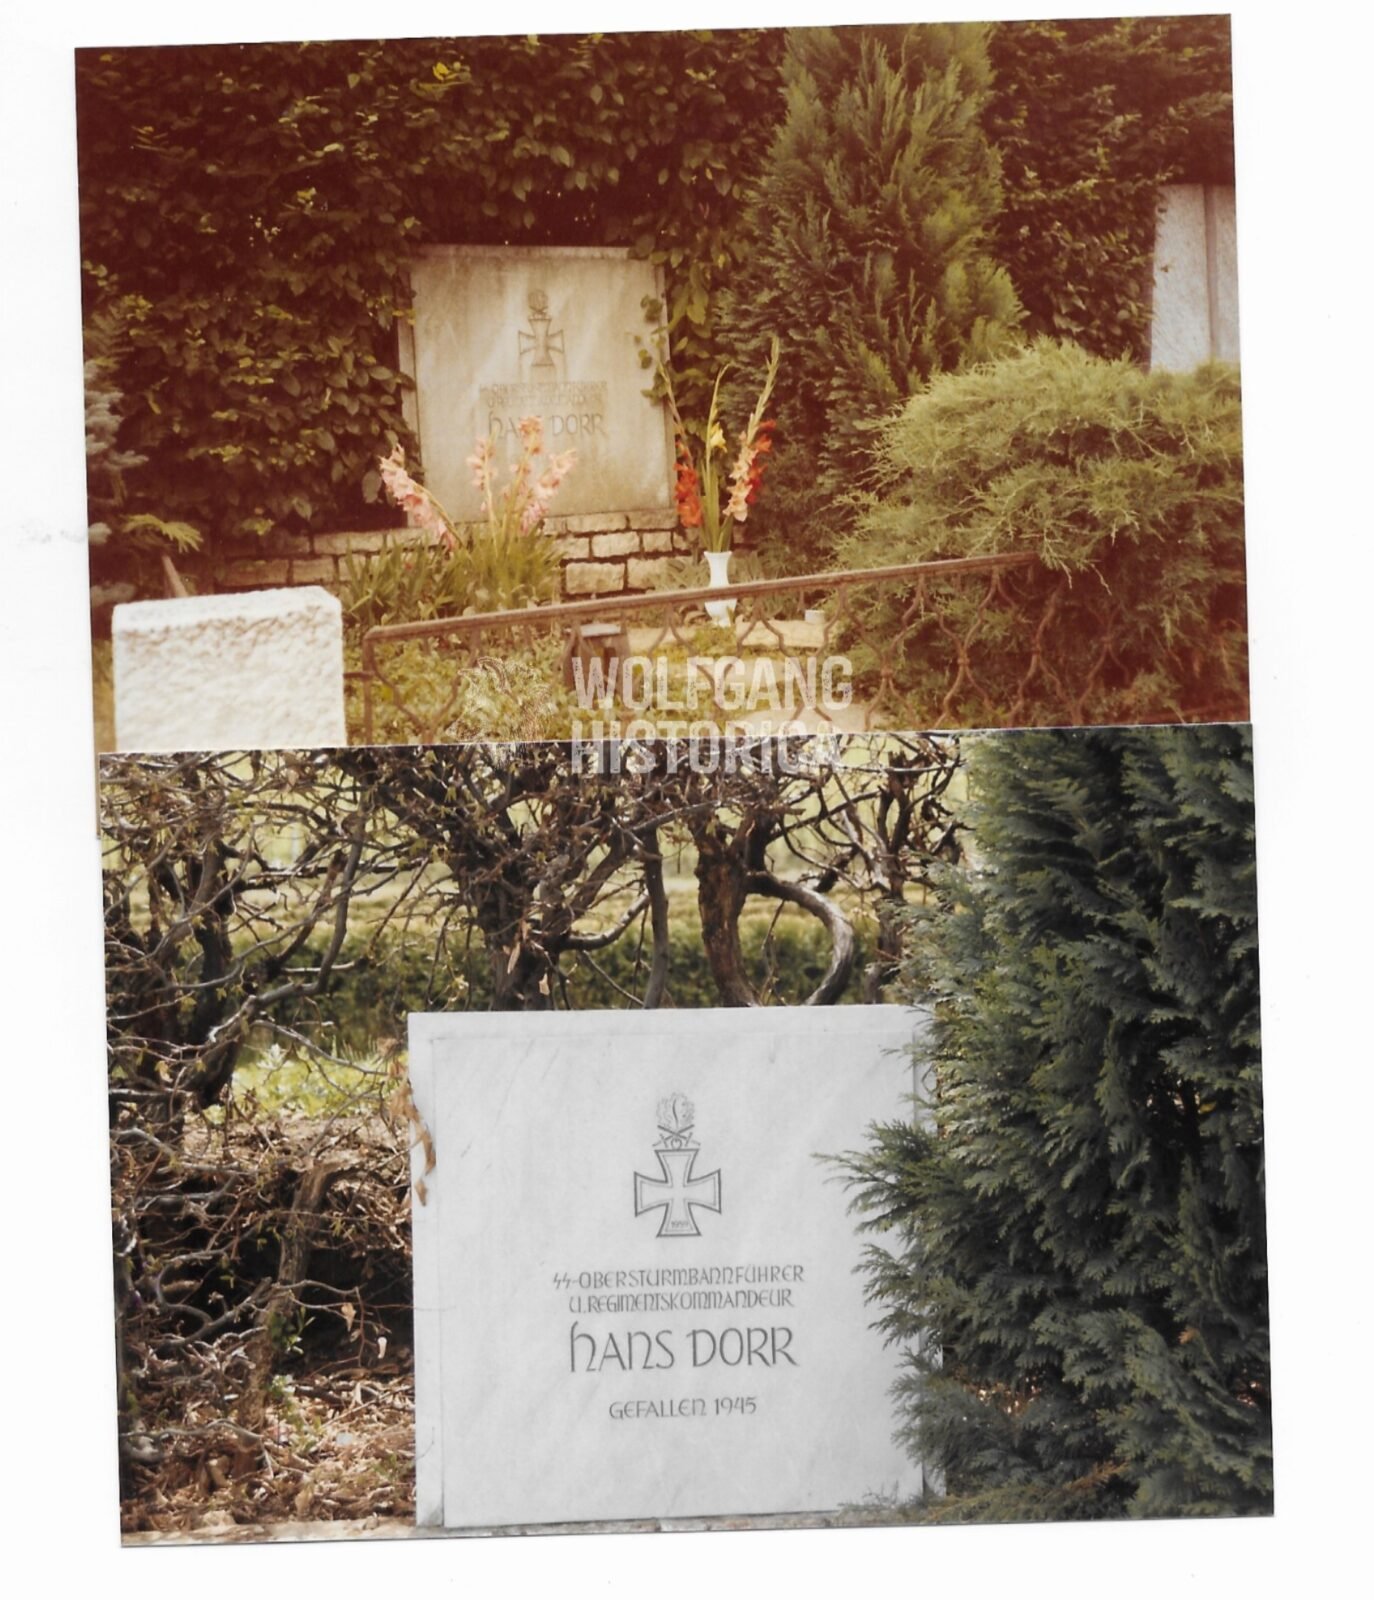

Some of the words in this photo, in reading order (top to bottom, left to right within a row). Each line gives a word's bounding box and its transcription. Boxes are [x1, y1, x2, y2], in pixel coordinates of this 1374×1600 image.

[686, 1326, 799, 1368] DORR
[609, 1398, 707, 1420] GEFALLEN
[714, 1396, 758, 1416] 1945
